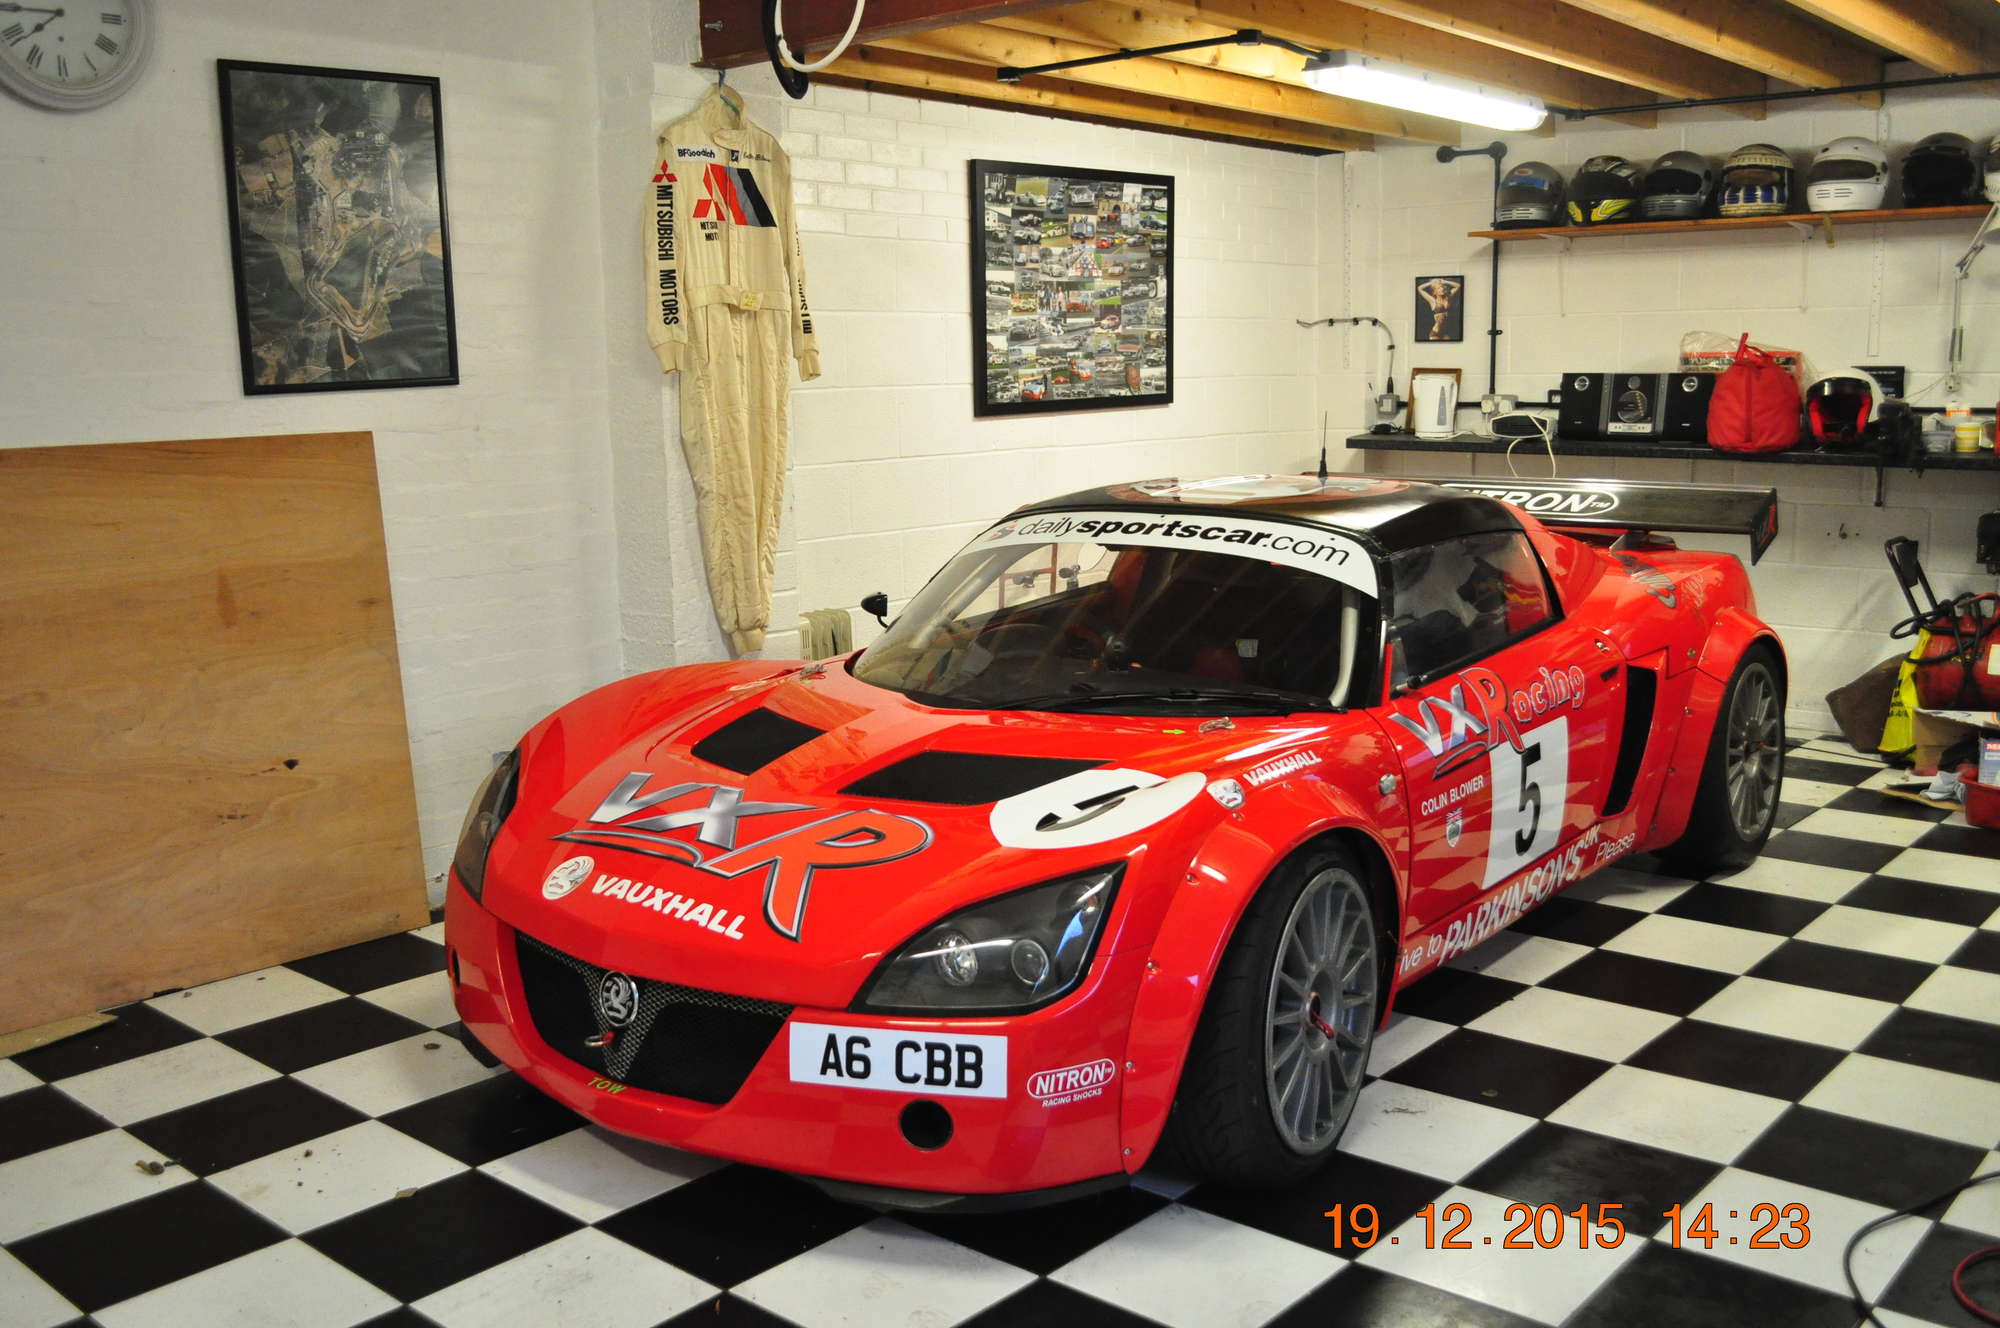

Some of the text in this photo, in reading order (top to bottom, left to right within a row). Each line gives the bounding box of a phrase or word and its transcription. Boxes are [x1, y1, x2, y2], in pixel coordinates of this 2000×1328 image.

[656, 184, 679, 326] MITSUBISHI MOTORS
[1018, 515, 1351, 567] dailysportscar.com
[1242, 750, 1323, 786] VAUXHALL
[1421, 775, 1484, 816] COLIN BLOWER
[1514, 742, 1542, 857] 5
[585, 771, 936, 943] VXR
[591, 872, 745, 941] VAUXHALL
[1427, 933, 1443, 958] to
[1593, 832, 1636, 865] Please
[587, 1076, 628, 1094] TOW
[820, 1032, 984, 1089] A6 CBB
[1035, 1062, 1106, 1097] NITRON
[1041, 1087, 1103, 1108] RACING SHOCKS
